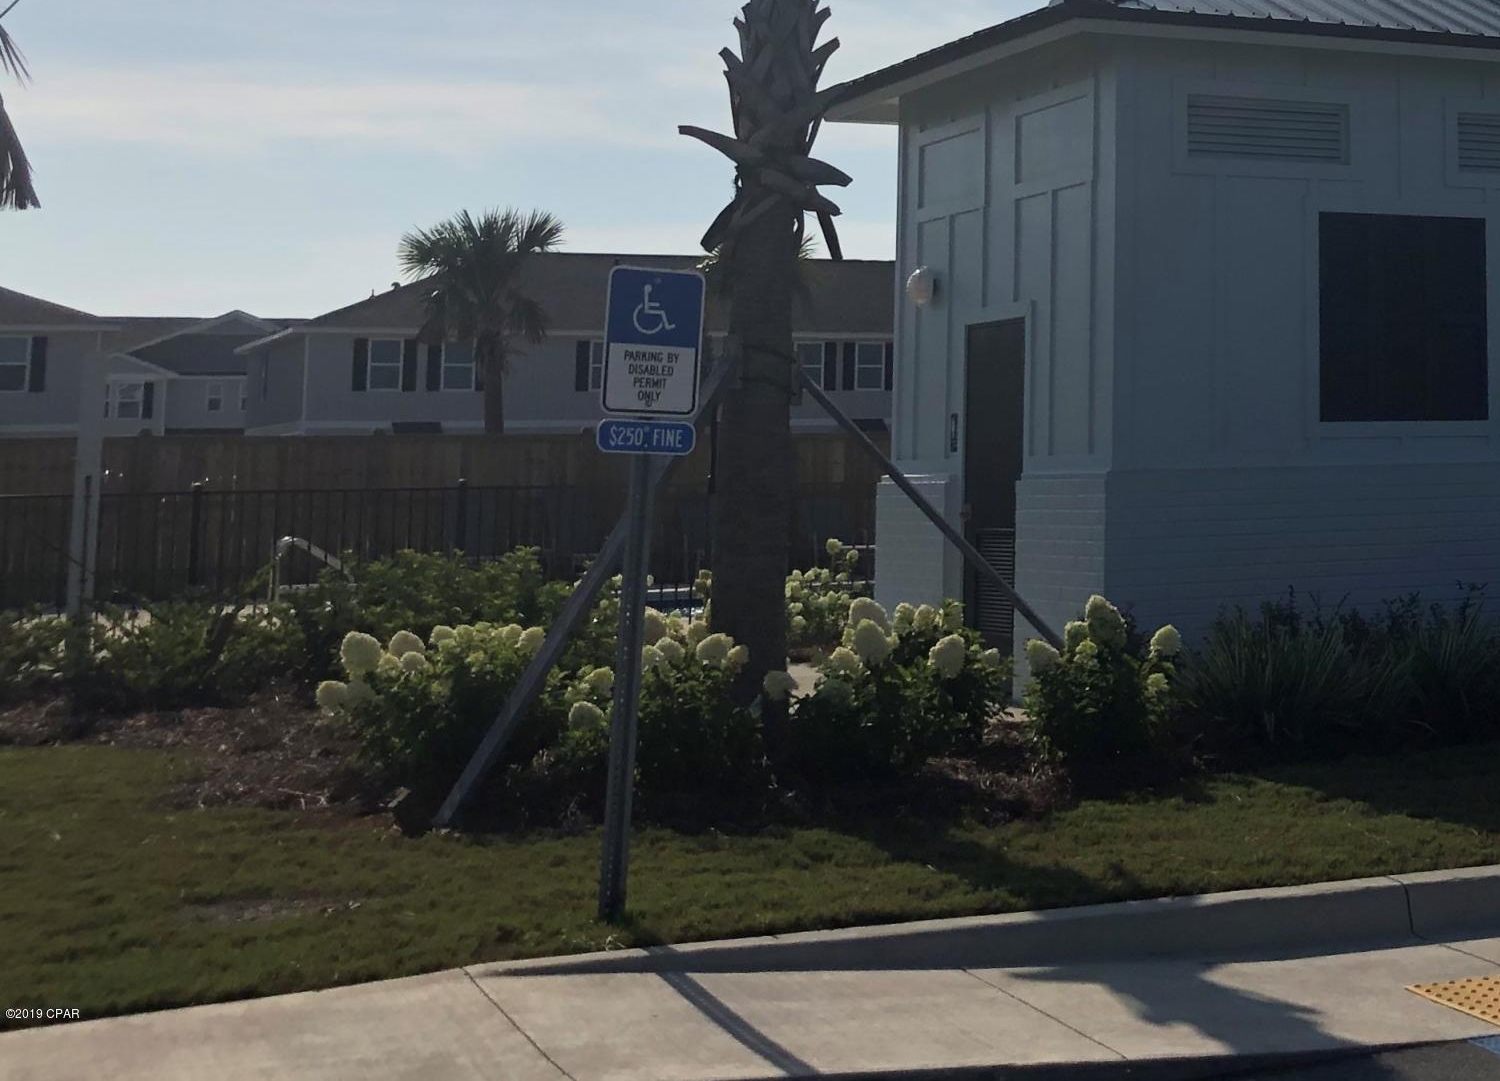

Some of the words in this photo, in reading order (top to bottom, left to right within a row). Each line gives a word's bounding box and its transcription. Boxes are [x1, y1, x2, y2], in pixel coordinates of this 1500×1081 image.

[624, 350, 663, 363] PARKING
[667, 352, 679, 364] BY
[628, 363, 674, 376] DISABLED
[633, 377, 667, 389] PERMIT
[637, 390, 662, 403] ONLY
[609, 426, 643, 447] $250
[653, 428, 683, 448] FINE
